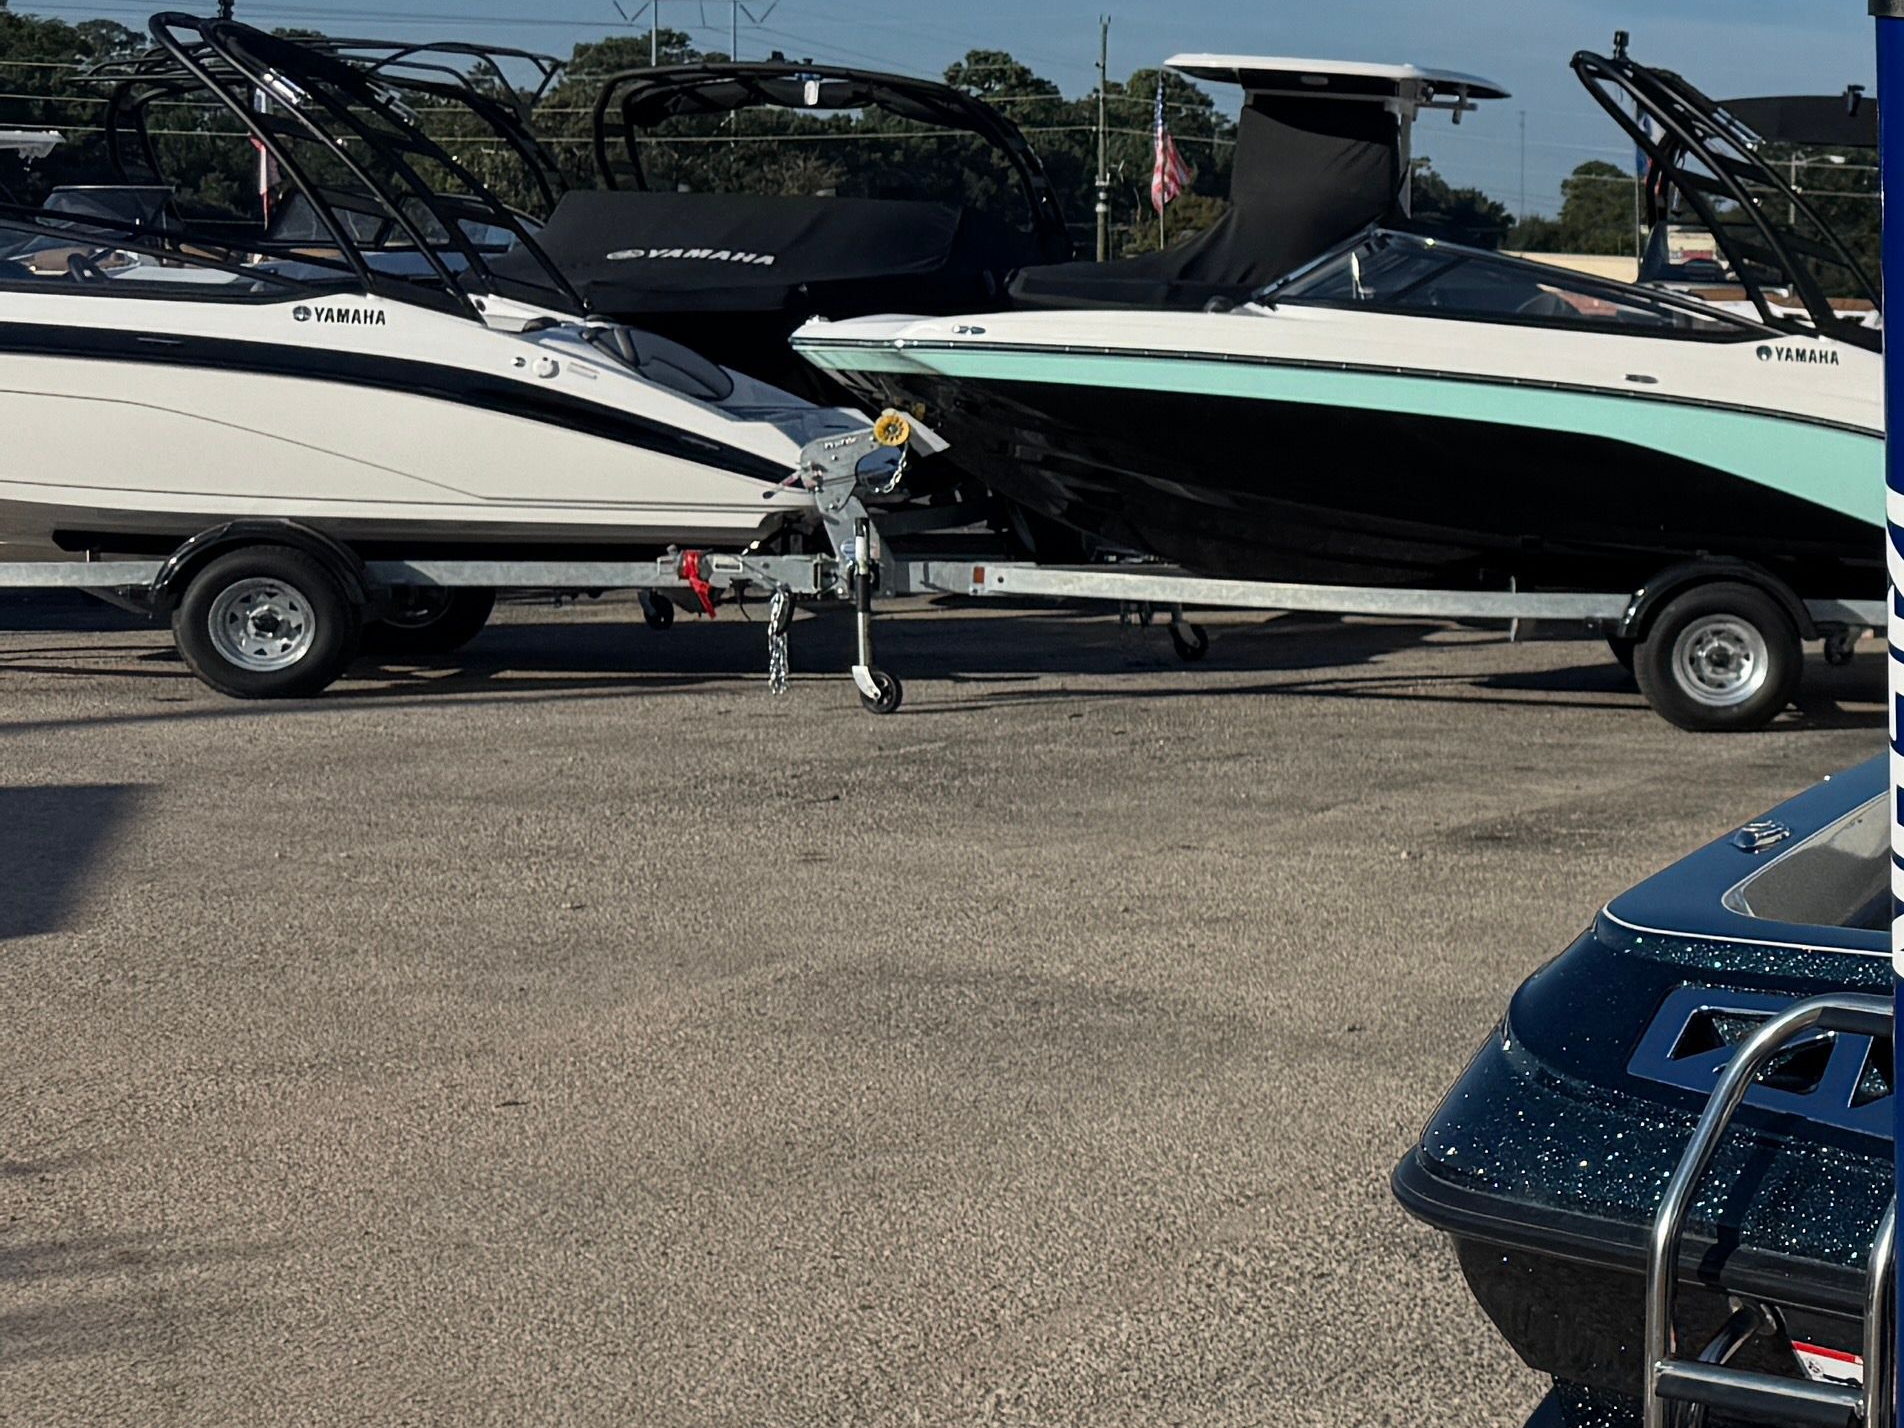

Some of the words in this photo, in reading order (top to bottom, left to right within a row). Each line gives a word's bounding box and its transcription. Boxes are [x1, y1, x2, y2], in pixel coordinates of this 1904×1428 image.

[647, 248, 776, 266] YAMAHA
[313, 307, 387, 326] YAMAHA
[1775, 346, 1840, 366] YAMAHA
